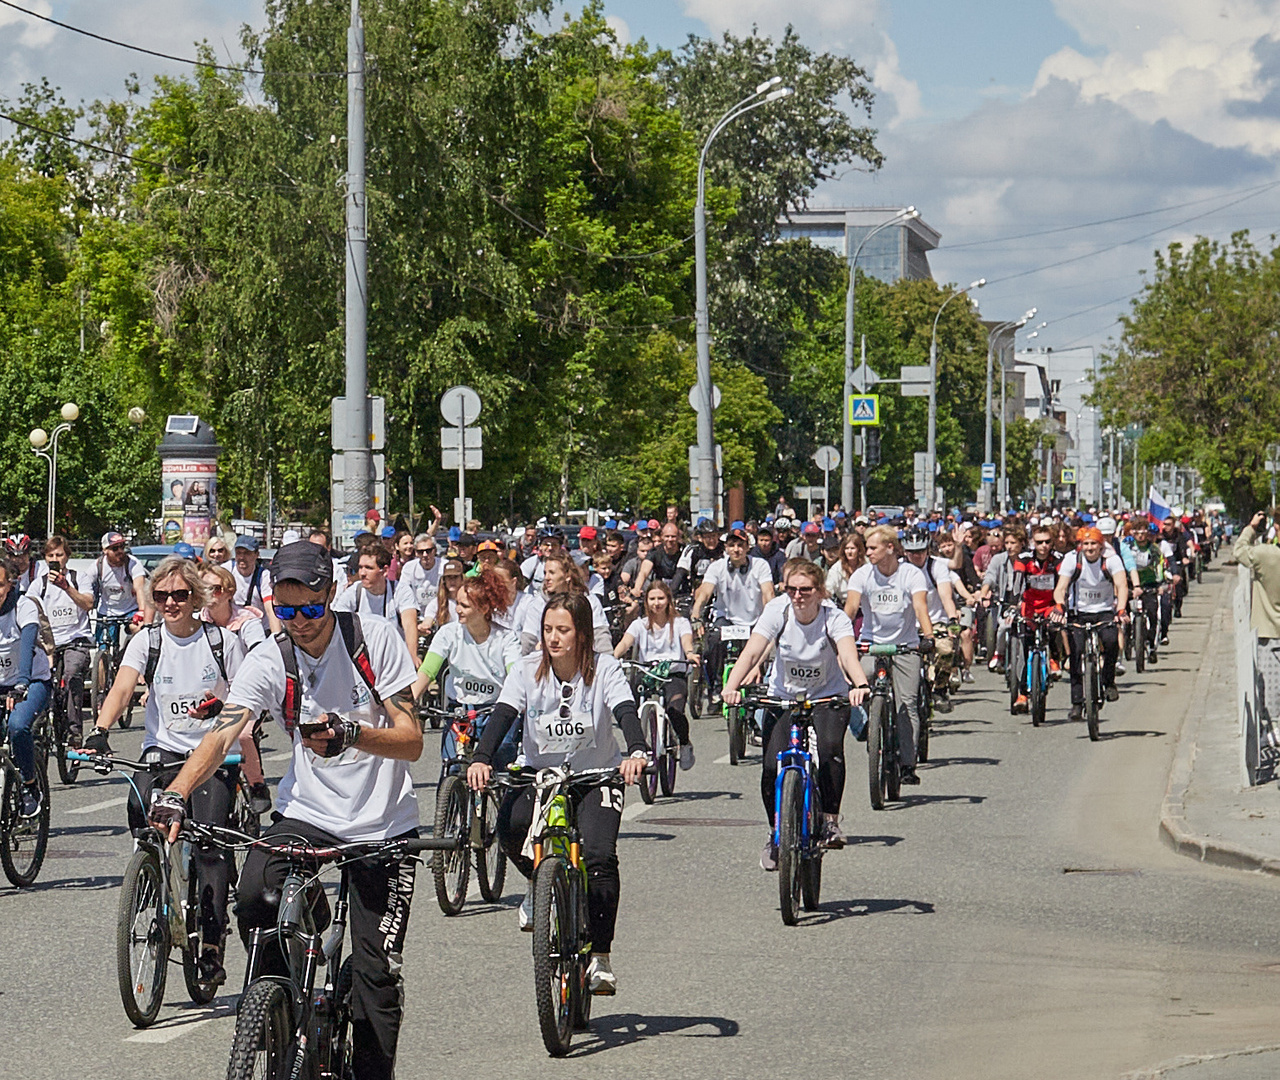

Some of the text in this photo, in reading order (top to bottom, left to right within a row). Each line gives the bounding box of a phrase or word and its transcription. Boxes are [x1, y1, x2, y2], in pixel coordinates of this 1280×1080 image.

[877, 594, 899, 603] 1008
[52, 608, 73, 617] 0052
[790, 667, 821, 678] 0025
[465, 681, 495, 694] 0009
[545, 722, 585, 737] 1006
[600, 786, 623, 812] 13
